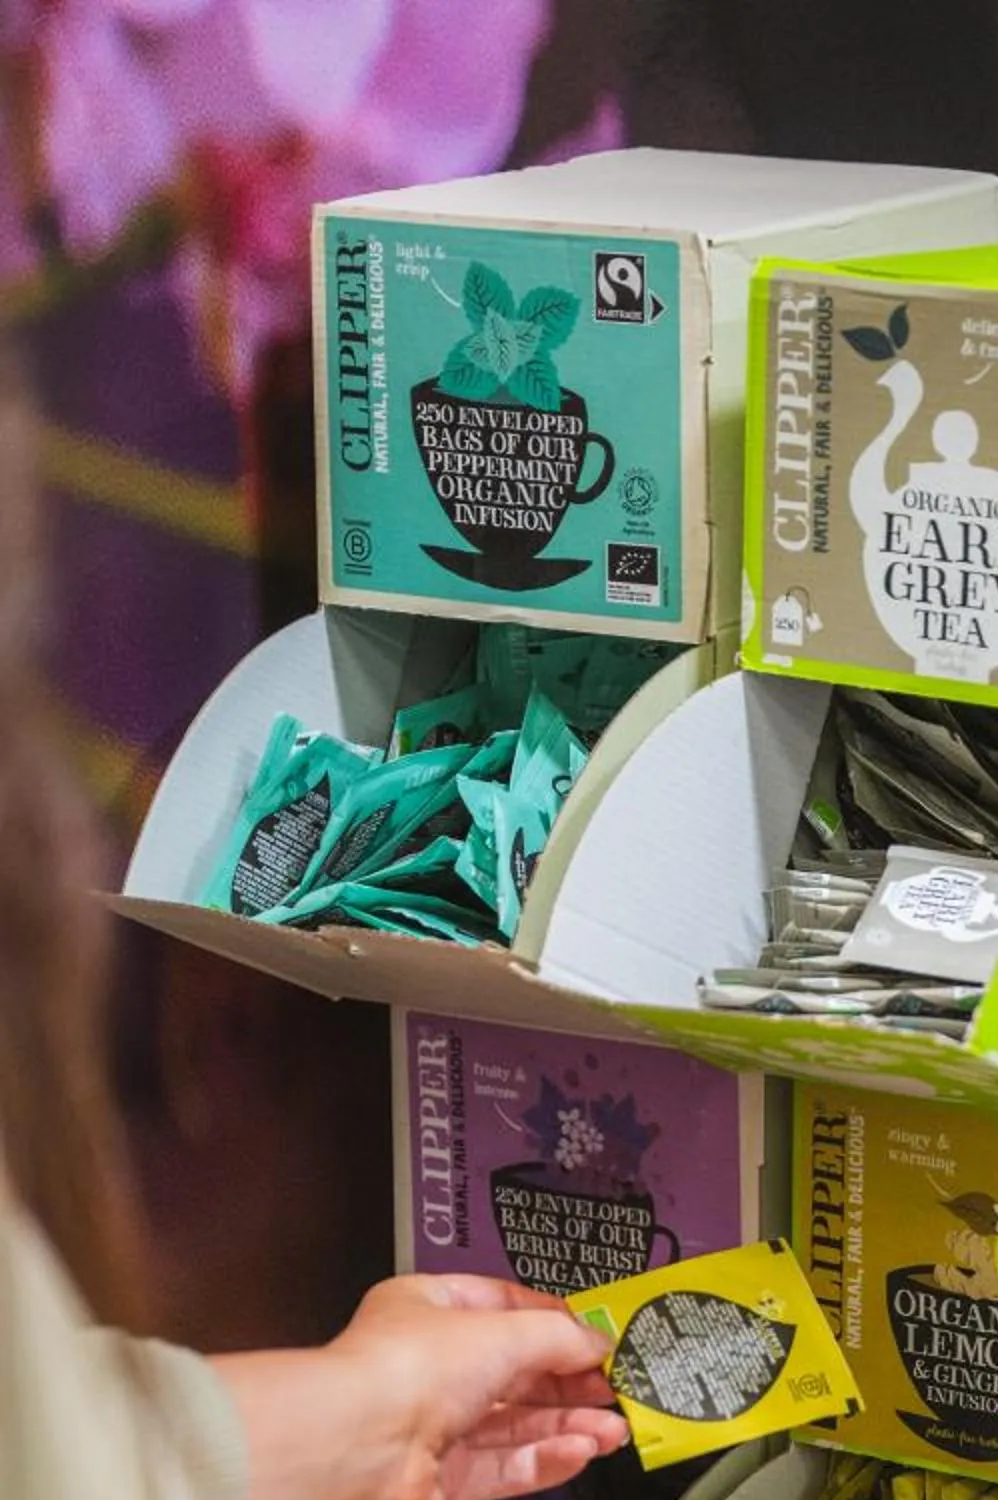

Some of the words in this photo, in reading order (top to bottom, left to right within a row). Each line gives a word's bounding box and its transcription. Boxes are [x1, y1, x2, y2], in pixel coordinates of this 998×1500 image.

[369, 240, 386, 330] DELICIOUS
[336, 240, 373, 472] CLIPPER
[816, 296, 834, 394] DELICIOUS
[371, 352, 387, 388] FAIR
[416, 402, 453, 424] 250
[458, 406, 583, 436] ENVELOPED
[773, 290, 818, 552] CLIPPER
[815, 419, 831, 459] FAIR
[422, 425, 483, 452] BAGS
[490, 431, 520, 455] OF
[527, 435, 578, 462] OUR
[428, 450, 577, 485] PEPPERMINT
[437, 474, 566, 509] ORGANIC
[454, 503, 554, 532] INFUSION
[914, 608, 990, 649] TEA
[418, 1032, 456, 1246] CLIPPER
[848, 1113, 865, 1205] DELICIOUS
[888, 1150, 957, 1176] warming
[495, 1185, 531, 1208] 250
[535, 1192, 651, 1227] ENVELOPED
[500, 1207, 559, 1235] BAGS
[565, 1217, 593, 1240] OF
[599, 1223, 647, 1251] OUR
[847, 1227, 863, 1263] FAIR
[506, 1231, 575, 1261] BERRY
[580, 1244, 646, 1272] BURST
[913, 1359, 929, 1379] &
